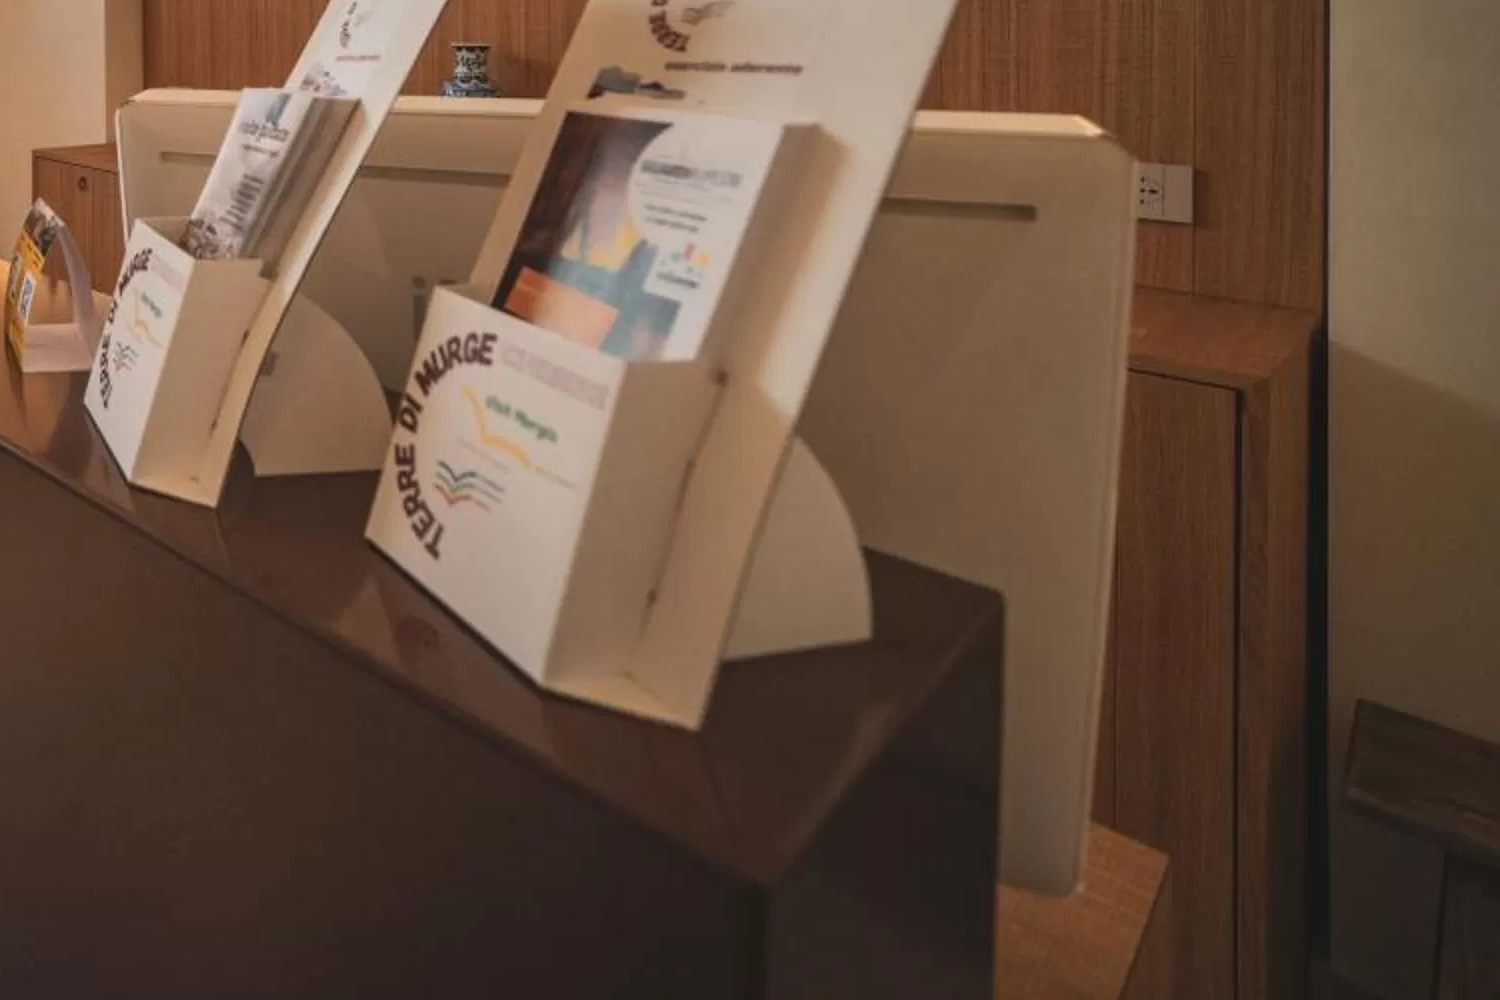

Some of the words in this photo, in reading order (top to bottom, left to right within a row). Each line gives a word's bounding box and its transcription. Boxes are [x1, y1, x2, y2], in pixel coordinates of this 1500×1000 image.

[648, 10, 691, 52] TERRE
[413, 331, 498, 397] MURGE
[398, 392, 424, 435] DI
[394, 443, 444, 561] TERRE
